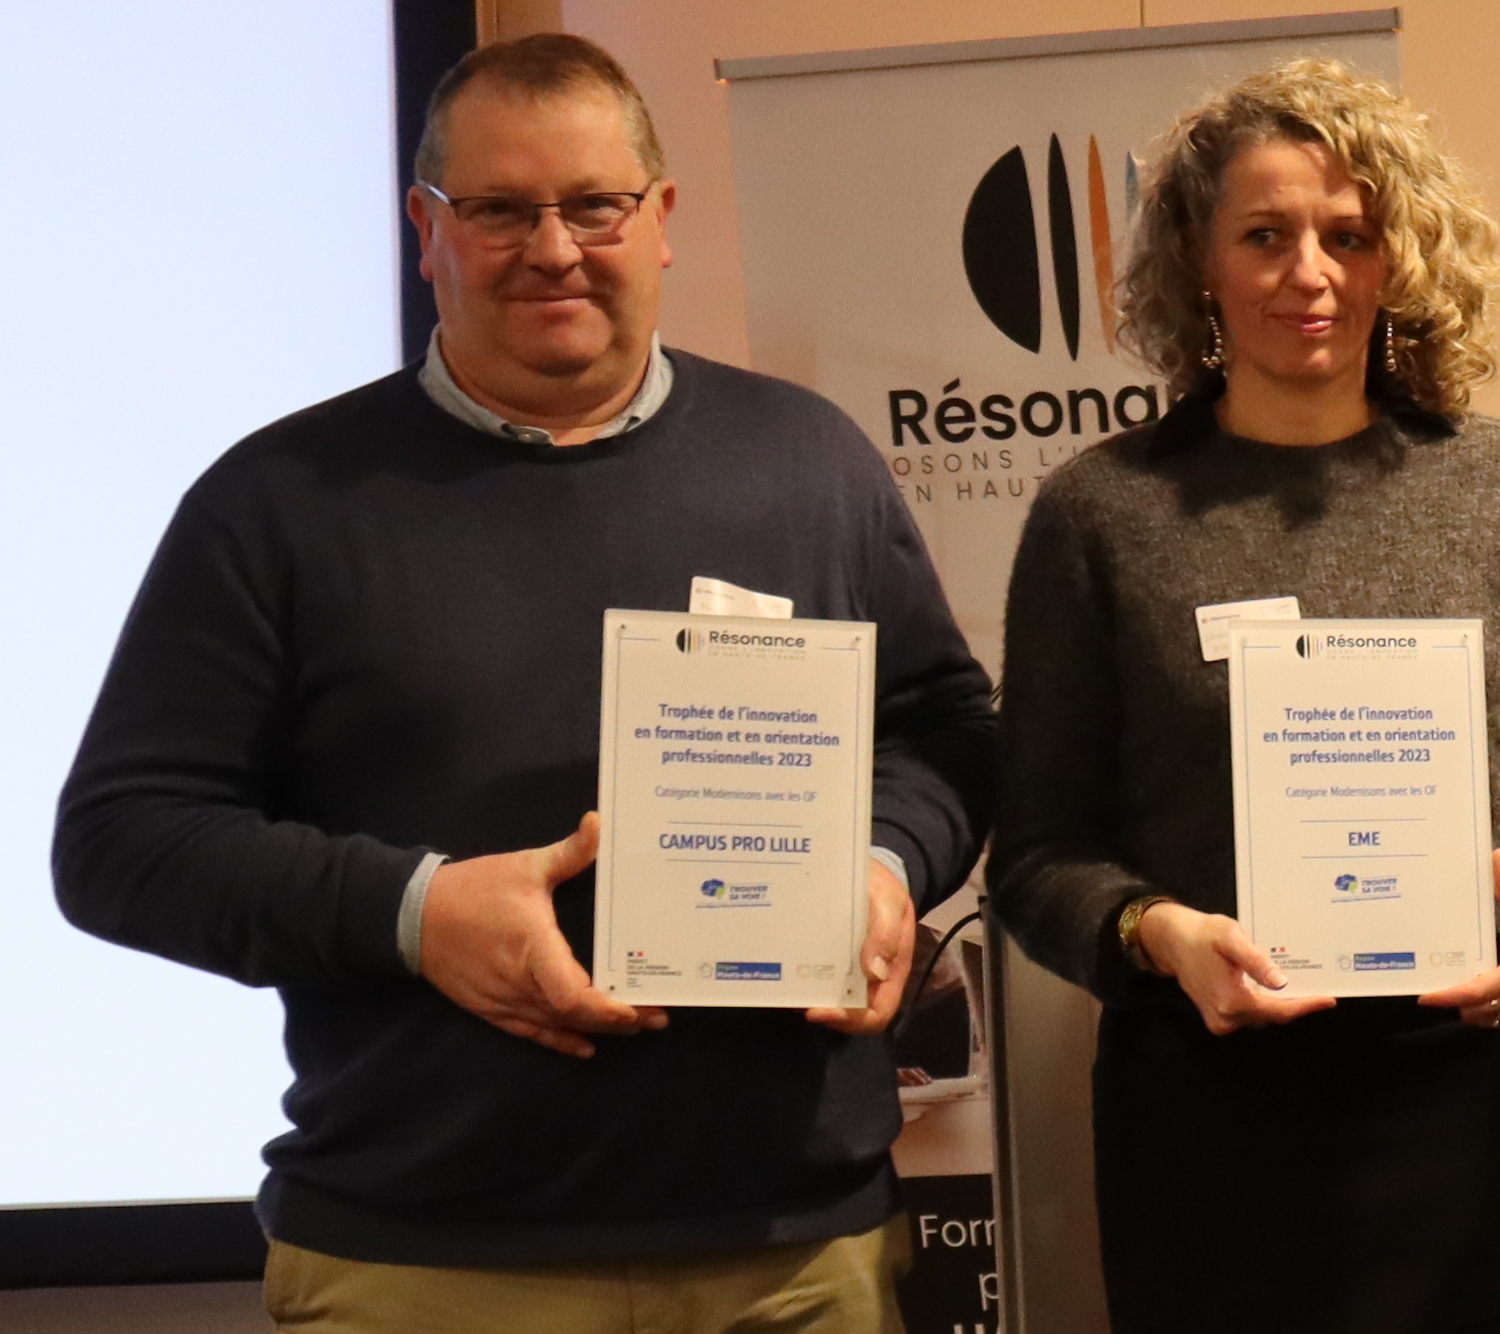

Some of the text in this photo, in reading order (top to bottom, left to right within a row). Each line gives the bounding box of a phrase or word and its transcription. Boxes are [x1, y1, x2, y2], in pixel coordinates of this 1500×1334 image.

[889, 378, 1164, 446] Résona
[893, 450, 1013, 476] OSONS
[709, 630, 805, 648] Résonance
[1326, 634, 1416, 647] Résonance
[658, 703, 715, 721] Trophée
[717, 706, 734, 720] de
[1284, 707, 1336, 723] Trophée
[1339, 707, 1355, 720] de
[634, 725, 839, 746] en formation et en orientation
[1263, 727, 1455, 742] en formation et en orientation
[661, 748, 811, 767] professionnelles 2023
[1290, 748, 1430, 766] professionnelles 2023
[659, 833, 810, 853] CAMPUS PRO LILLE
[1348, 831, 1380, 846] EME
